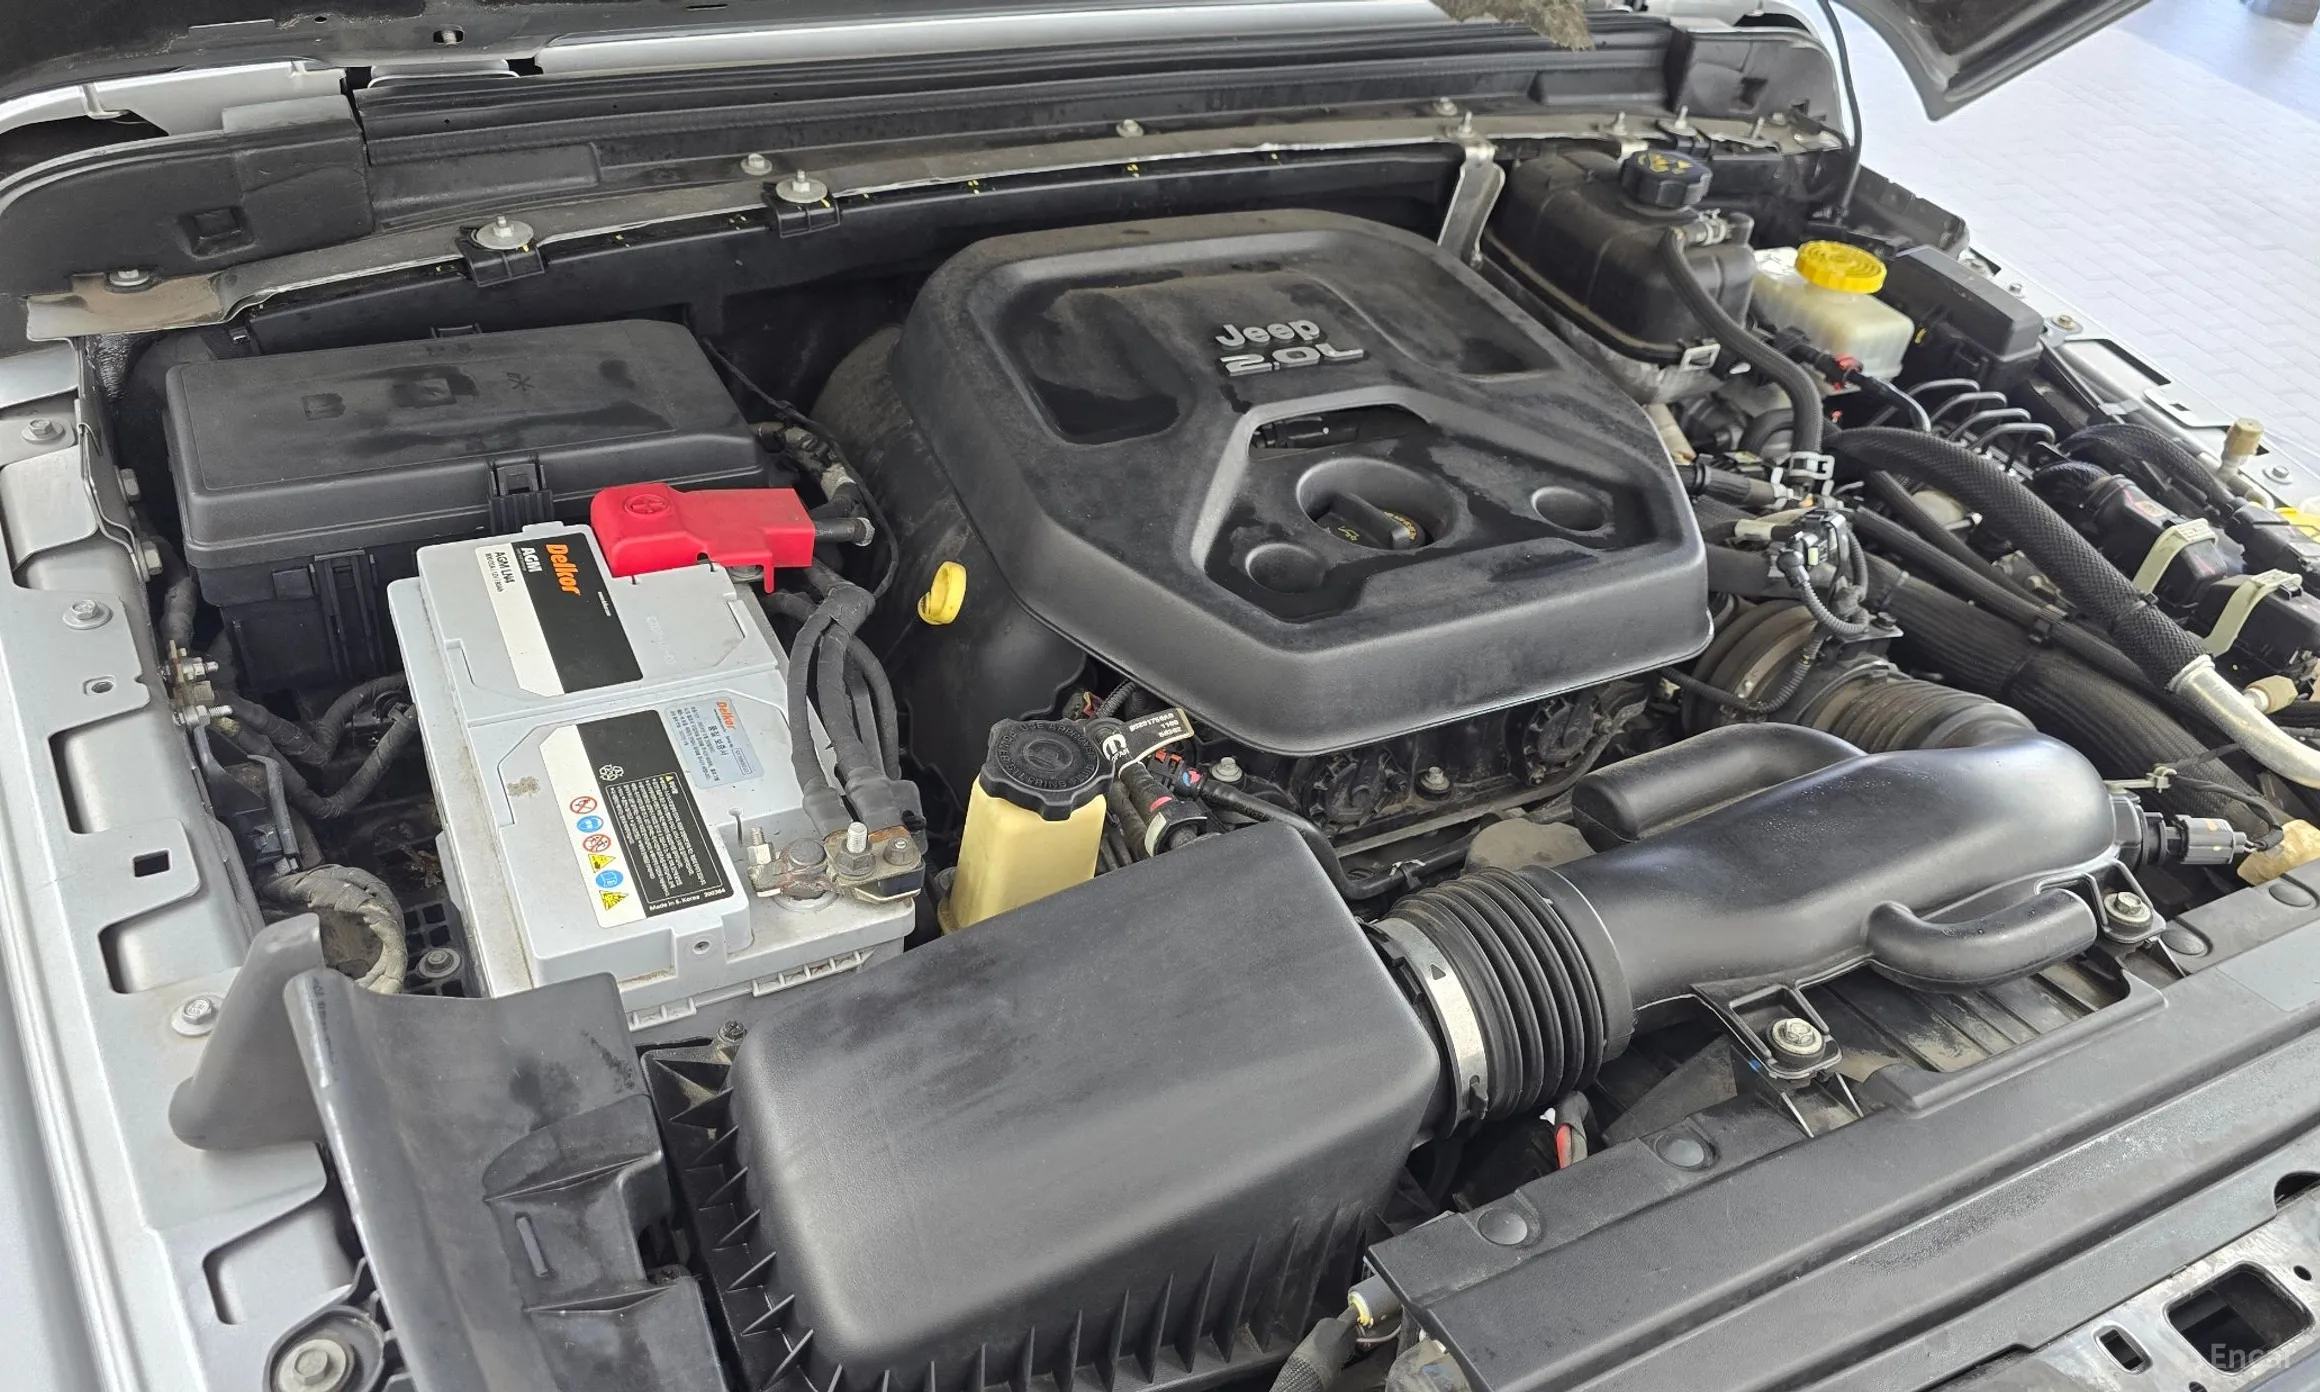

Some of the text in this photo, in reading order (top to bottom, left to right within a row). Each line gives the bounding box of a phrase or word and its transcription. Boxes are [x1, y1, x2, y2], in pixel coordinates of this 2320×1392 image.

[1215, 319, 1320, 347] Jeep
[1219, 343, 1364, 376] 2.0L
[520, 547, 543, 573] AGM
[546, 544, 582, 596] Delkor
[716, 701, 736, 730] Delkor
[1020, 722, 1045, 731] USE
[649, 902, 668, 911] Made
[681, 894, 700, 903] Korea
